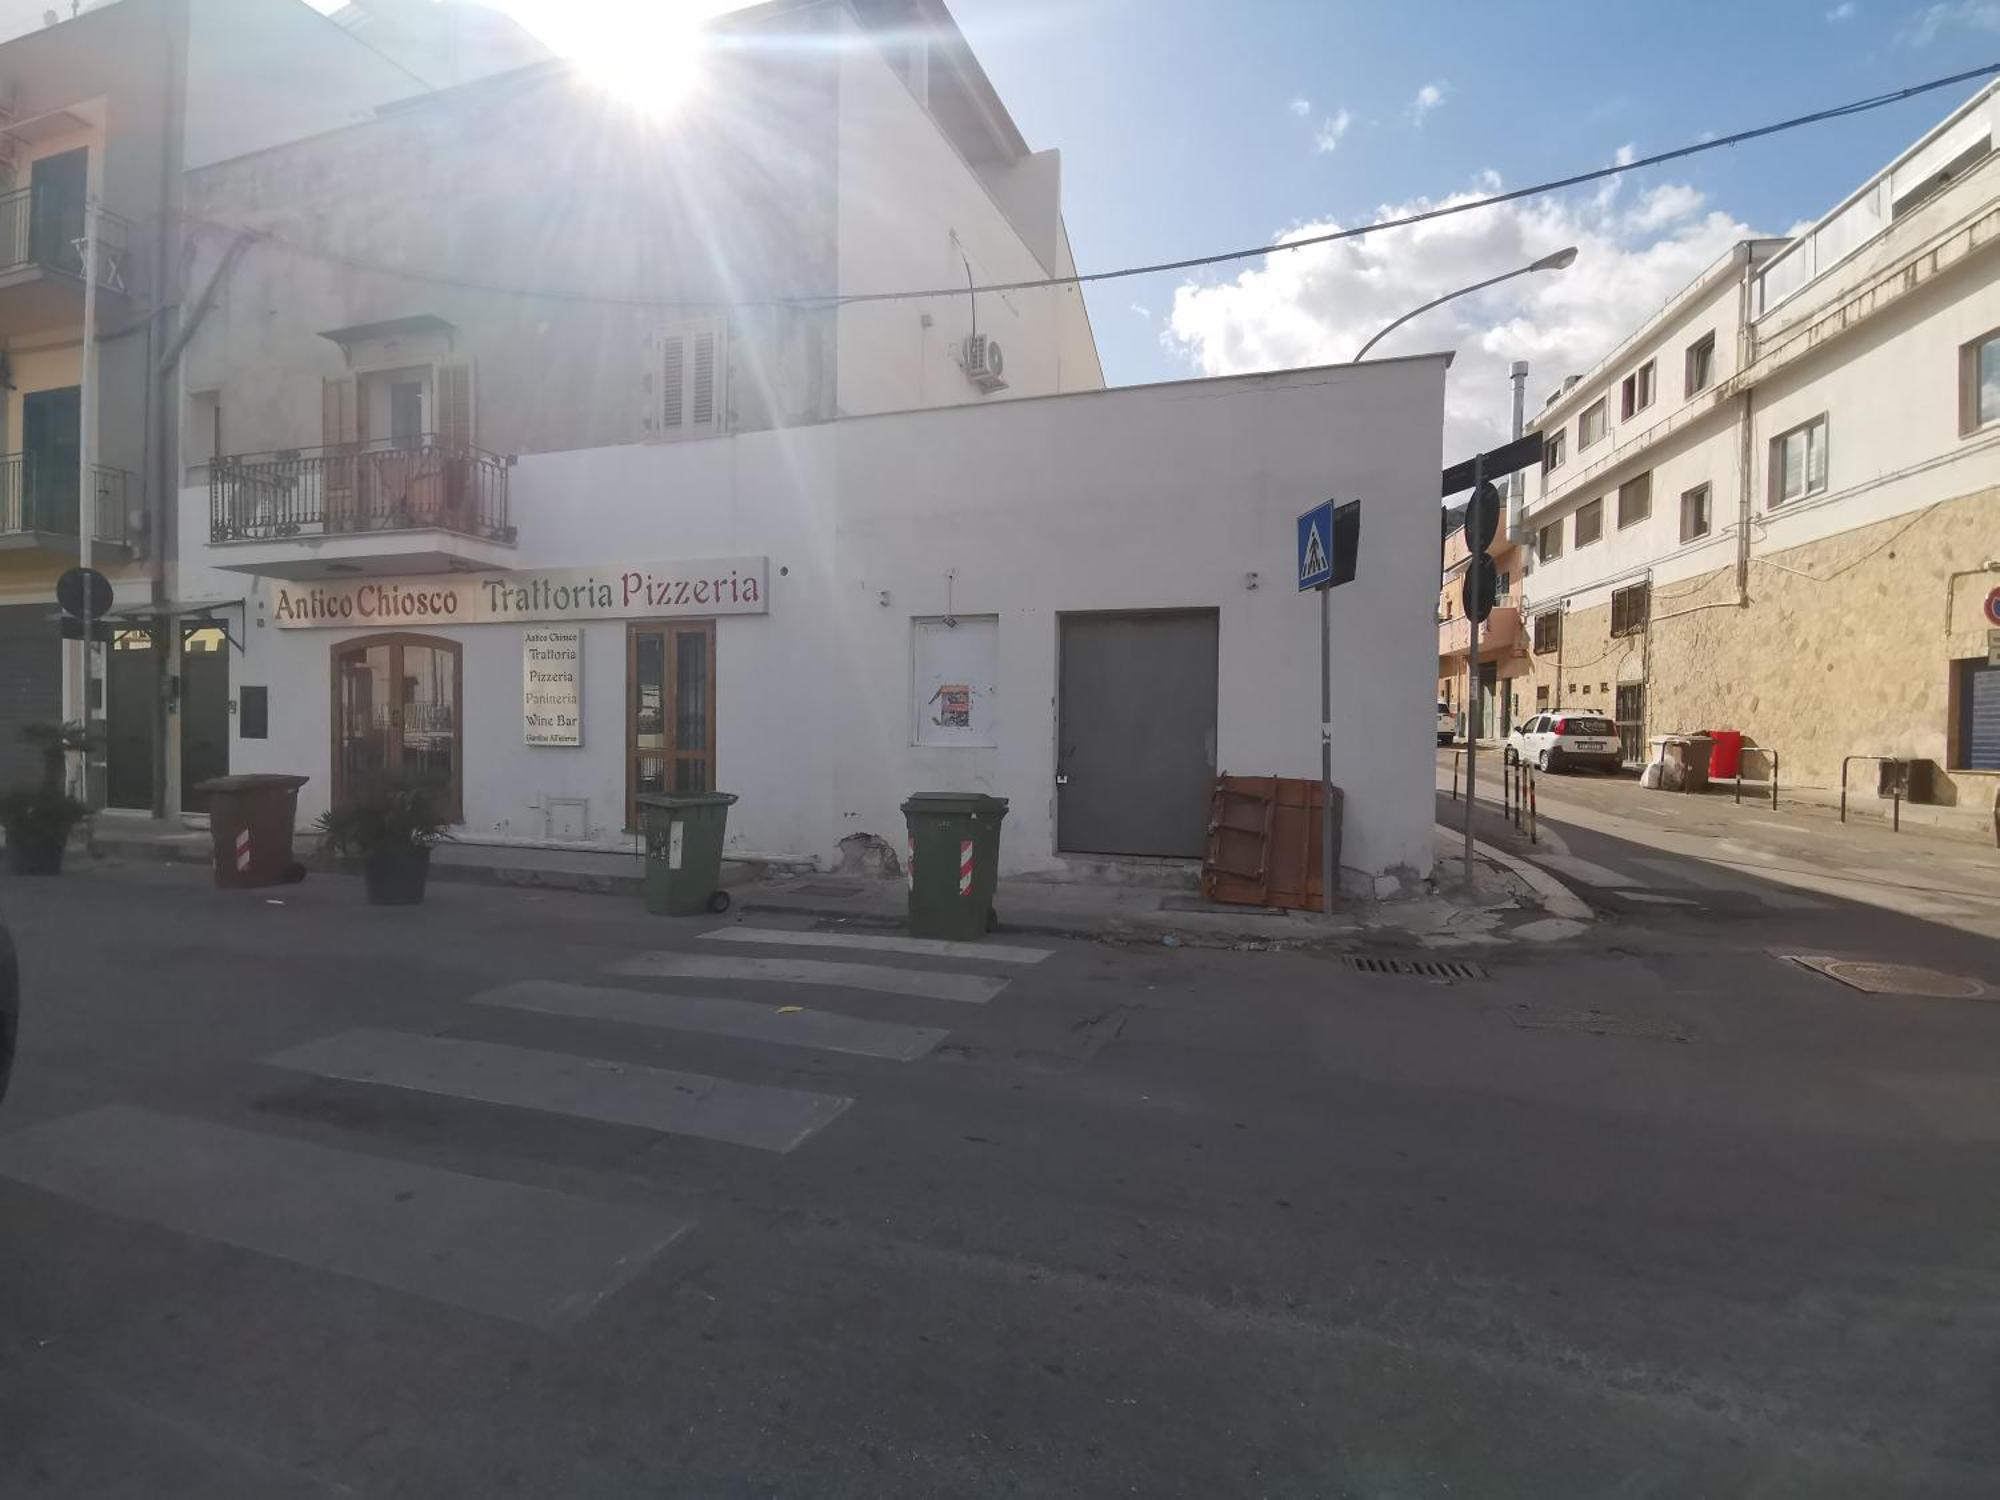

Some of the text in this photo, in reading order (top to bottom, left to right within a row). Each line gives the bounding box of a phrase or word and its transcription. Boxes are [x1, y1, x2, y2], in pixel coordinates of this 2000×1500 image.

[275, 570, 760, 620] Antico Chiosco Trattoria Pizzeria
[529, 649, 577, 660] Trattoria
[529, 670, 573, 682] Pizzeria
[526, 692, 577, 704] Panineria
[526, 714, 577, 726] Wine Bar
